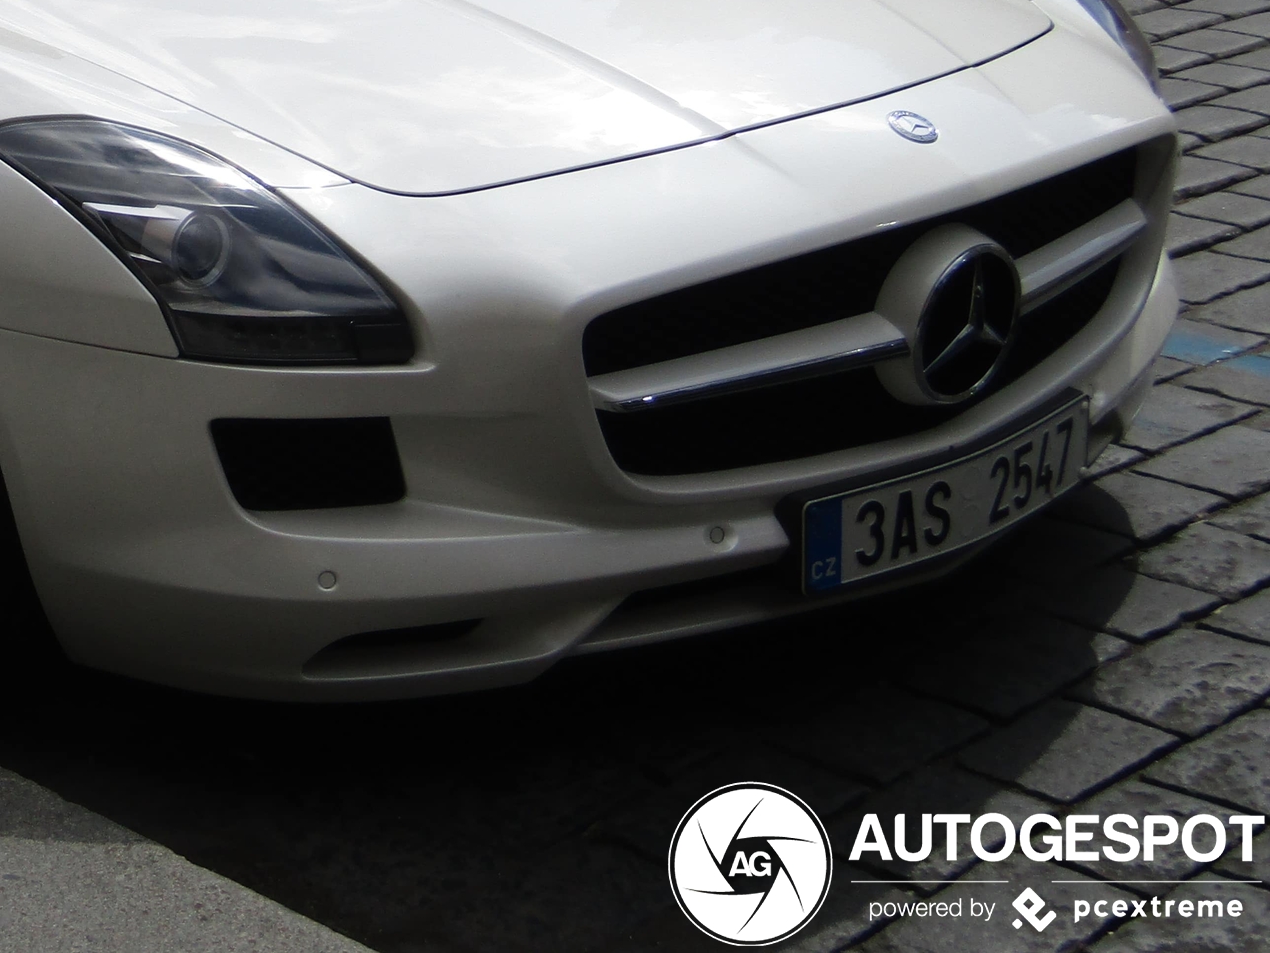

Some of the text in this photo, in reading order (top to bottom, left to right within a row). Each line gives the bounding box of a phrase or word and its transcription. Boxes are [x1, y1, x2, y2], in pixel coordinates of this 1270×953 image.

[811, 417, 1073, 580] CZ 3AS 2547
